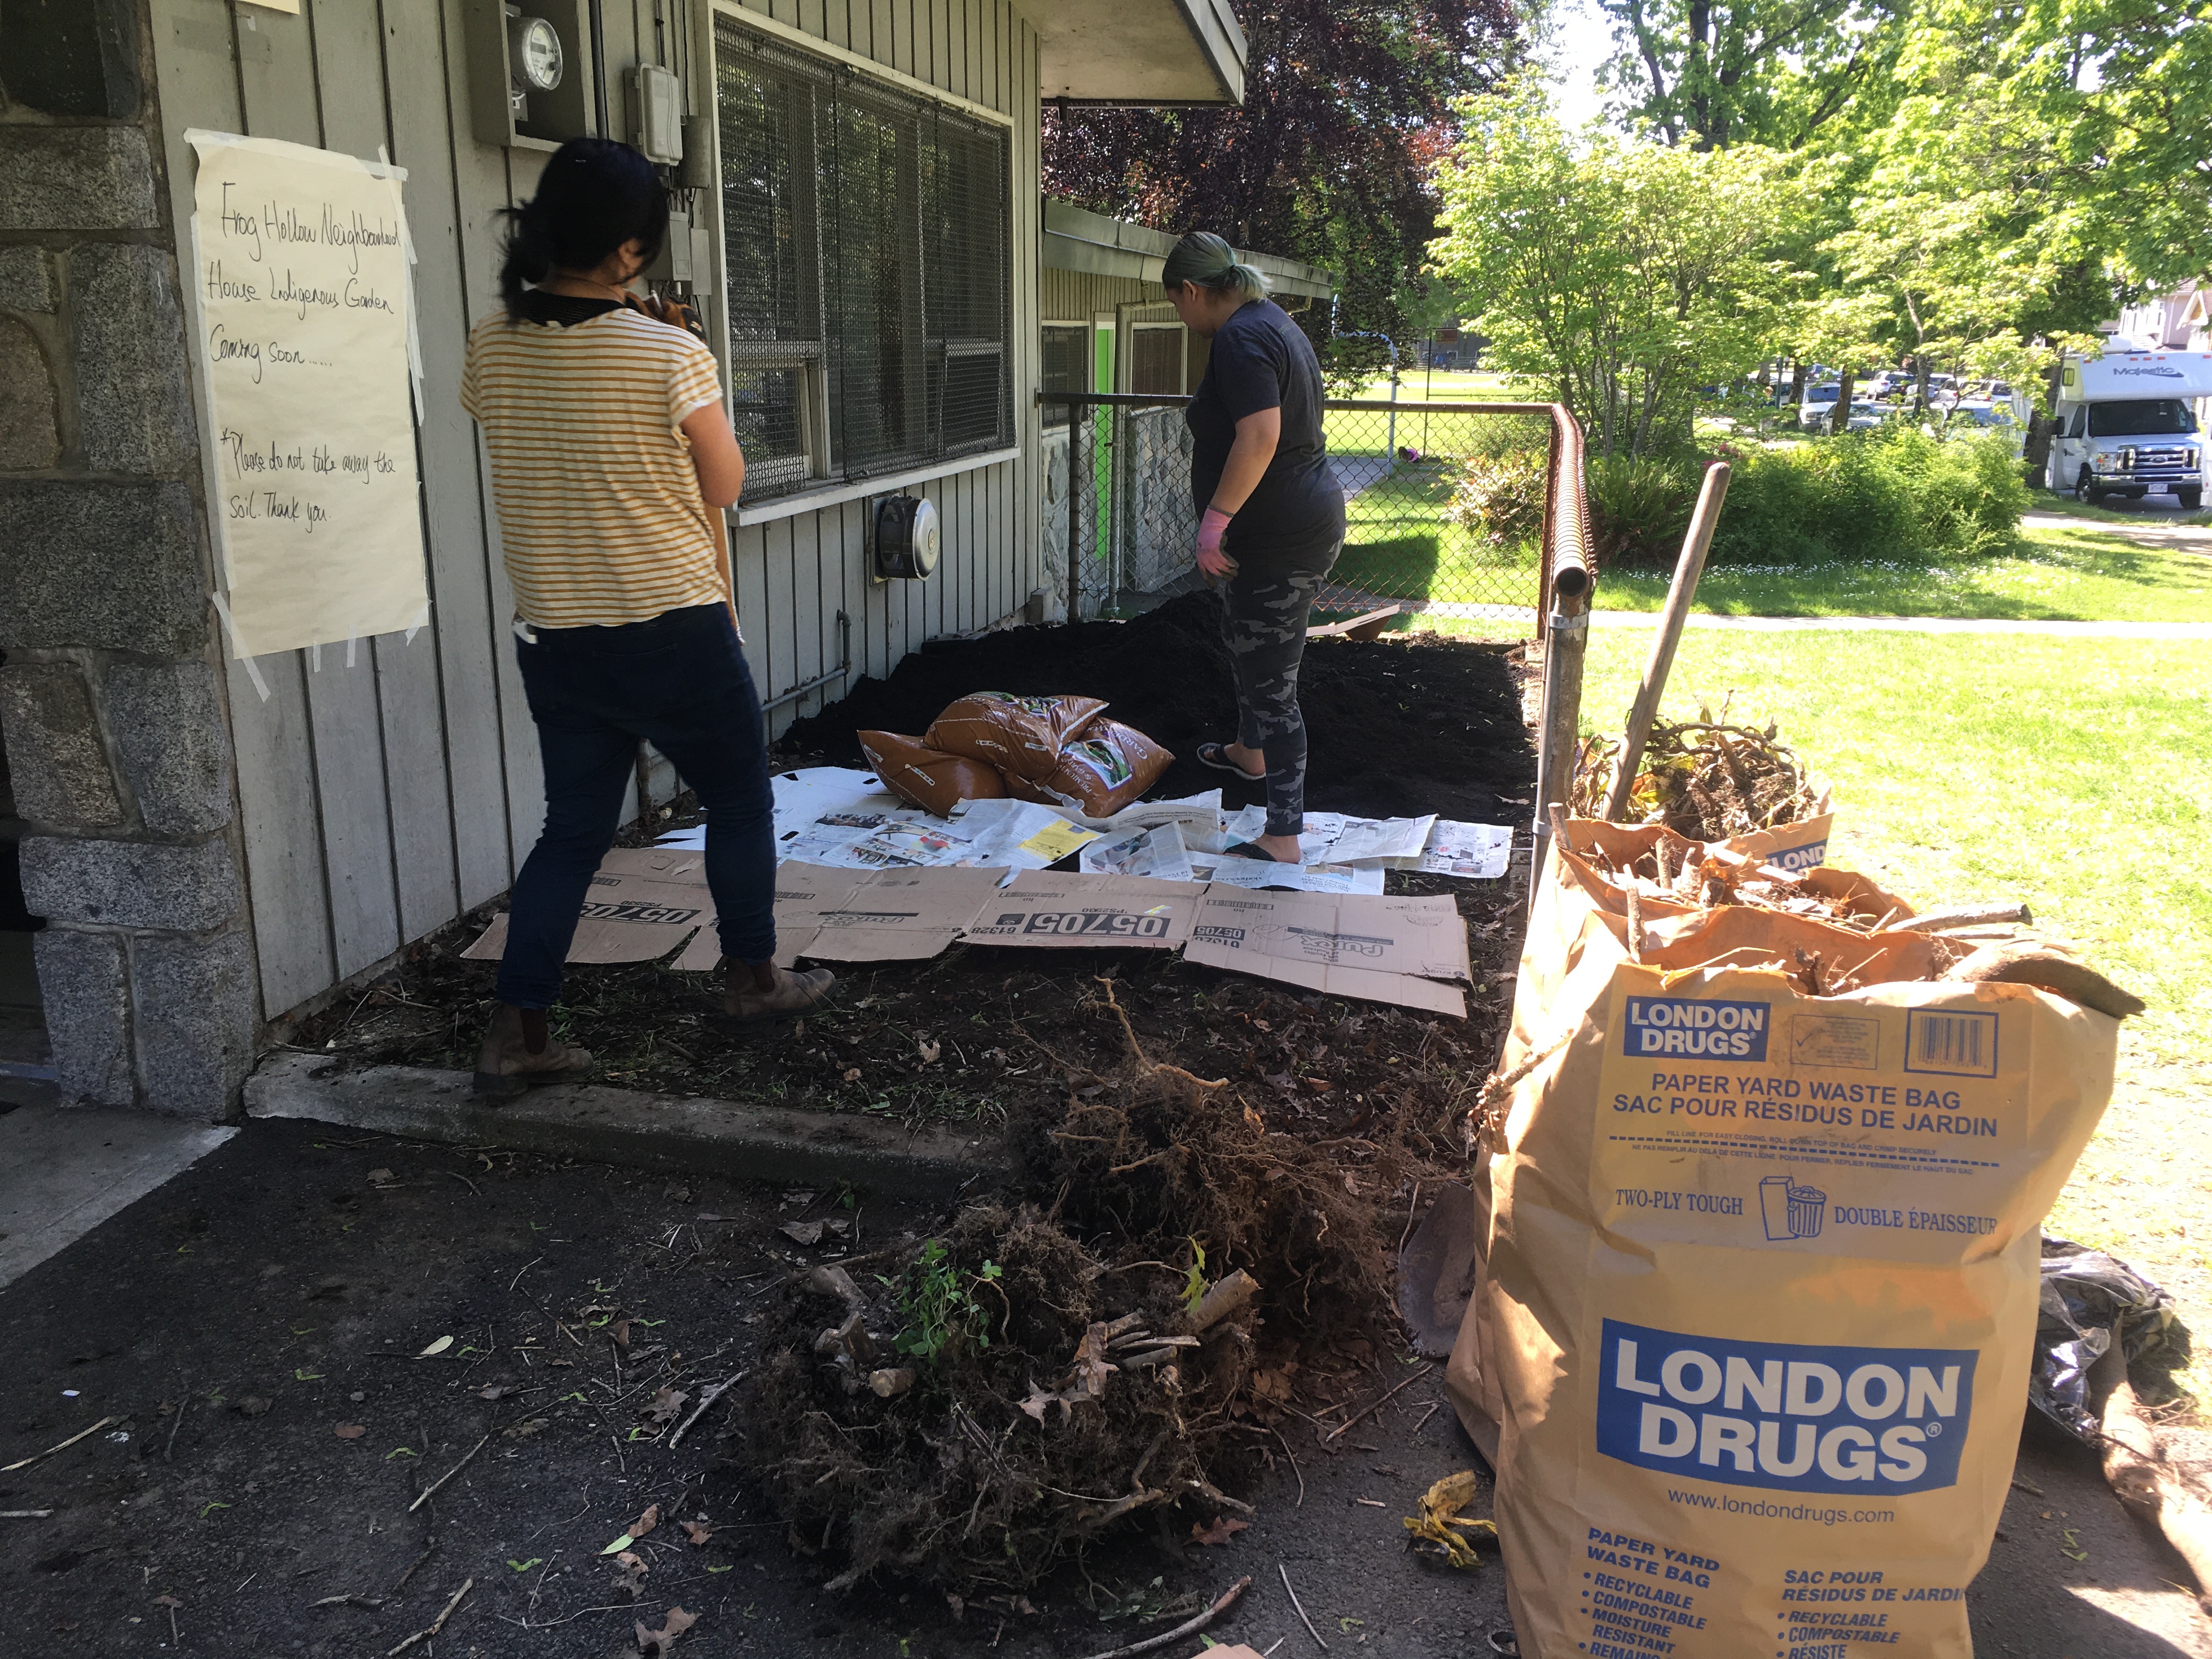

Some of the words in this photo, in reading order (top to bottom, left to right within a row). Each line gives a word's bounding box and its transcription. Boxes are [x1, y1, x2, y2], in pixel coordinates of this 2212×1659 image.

[221, 182, 261, 262] Frog
[264, 200, 316, 243] Hollow
[208, 259, 261, 302] House
[269, 267, 338, 320] Indigenous
[345, 278, 394, 314] Garden
[210, 323, 262, 384] Coming
[2113, 366, 2175, 376] Majestic
[269, 440, 283, 471] do
[287, 446, 305, 470] not
[312, 444, 337, 475] take
[342, 455, 369, 484] away
[374, 450, 396, 473] the
[263, 492, 299, 522] Thank
[1064, 768, 1093, 794] PREMIUM
[1031, 913, 1164, 936] 05705
[1197, 927, 1243, 939] 05705
[1300, 935, 1384, 957] Purex
[1632, 1003, 1763, 1030] LONDON
[1652, 1073, 1729, 1094] PAPER
[1737, 1077, 1801, 1098] YARD
[1809, 1081, 1897, 1105] WASTE
[1905, 1088, 1961, 1110] BAG
[1613, 1094, 1662, 1114] SAC
[1671, 1097, 1736, 1118] POUR
[1745, 1097, 1853, 1126] RÉSIDUS
[1861, 1108, 1895, 1129] DE
[1902, 1113, 1997, 1137] JARDIN
[1835, 1159, 1864, 1167] REPLIER
[1866, 1161, 1911, 1170] FERMEMENT
[1899, 1147, 1937, 1155] SECURELY
[1616, 1188, 1682, 1211] TWO-PLY
[1686, 1193, 1744, 1216] TOUGH
[1834, 1206, 1904, 1228] DOUBLE
[1909, 1206, 1997, 1235] ÉPAISSEUR
[1615, 1338, 1961, 1421] LONDON
[1667, 1487, 1895, 1527] www.londondrugs.com
[1588, 1527, 1656, 1556] PAPER
[1663, 1547, 1720, 1572] YARD
[1587, 1545, 1660, 1576] WASTE
[1665, 1566, 1711, 1589] BAG
[1784, 1570, 1825, 1584] SAC
[1829, 1571, 1884, 1584] POUR
[1594, 1572, 1694, 1610] RECYCLABLE
[1782, 1585, 1866, 1602] RÉSIDUS
[1871, 1588, 1898, 1601] DE
[1592, 1608, 1672, 1639] MOISTURE
[1593, 1590, 1707, 1630] COMPOSTABLE
[1788, 1611, 1889, 1628] RECYCLABLE
[1592, 1624, 1677, 1655] RESISTANT
[1789, 1626, 1901, 1644] COMPOSTABLE
[1789, 1643, 1848, 1659] RÉSISTE
